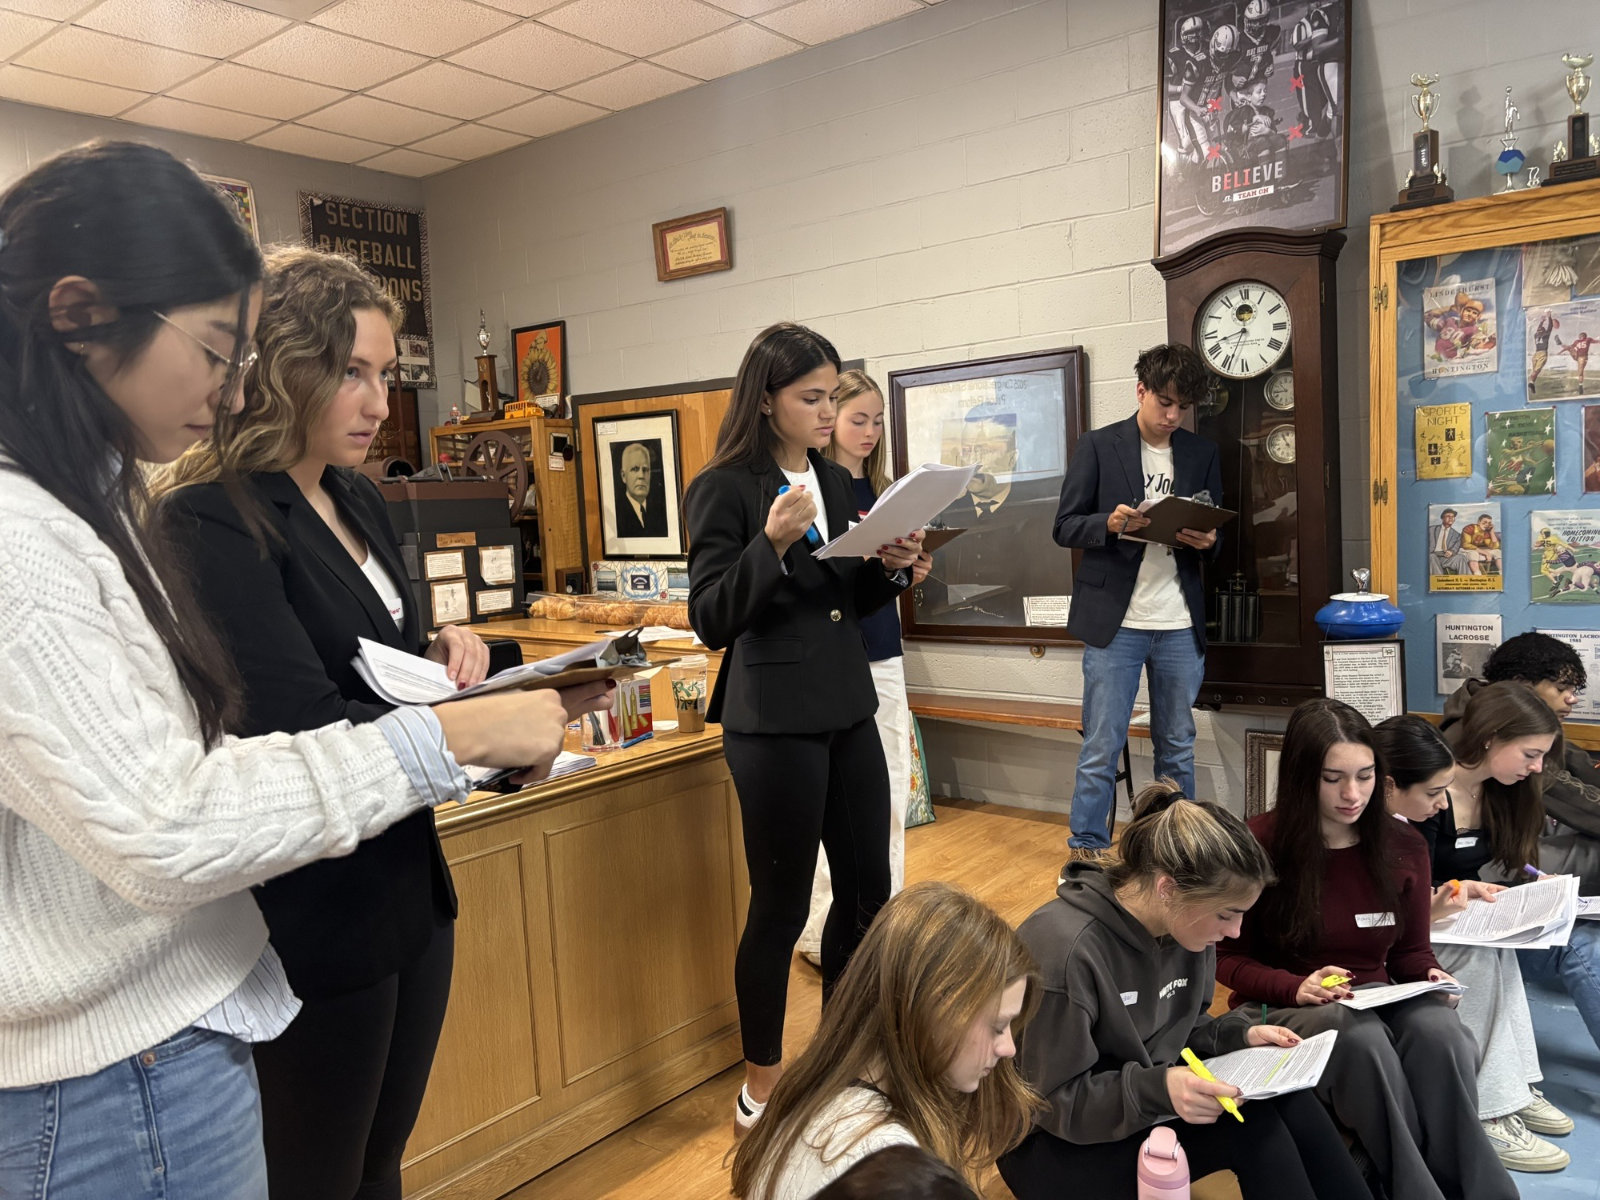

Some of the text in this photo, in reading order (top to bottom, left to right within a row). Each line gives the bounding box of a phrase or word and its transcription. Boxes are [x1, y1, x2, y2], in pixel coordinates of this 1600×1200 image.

[1212, 161, 1283, 192] BELIEVE
[1237, 189, 1257, 200] TEAM
[325, 202, 407, 236] SECTION
[319, 234, 416, 269] BASEBALL
[1430, 284, 1490, 298] LINDEHURST
[1423, 404, 1467, 418] SPORTS
[1427, 415, 1460, 426] NIGHT
